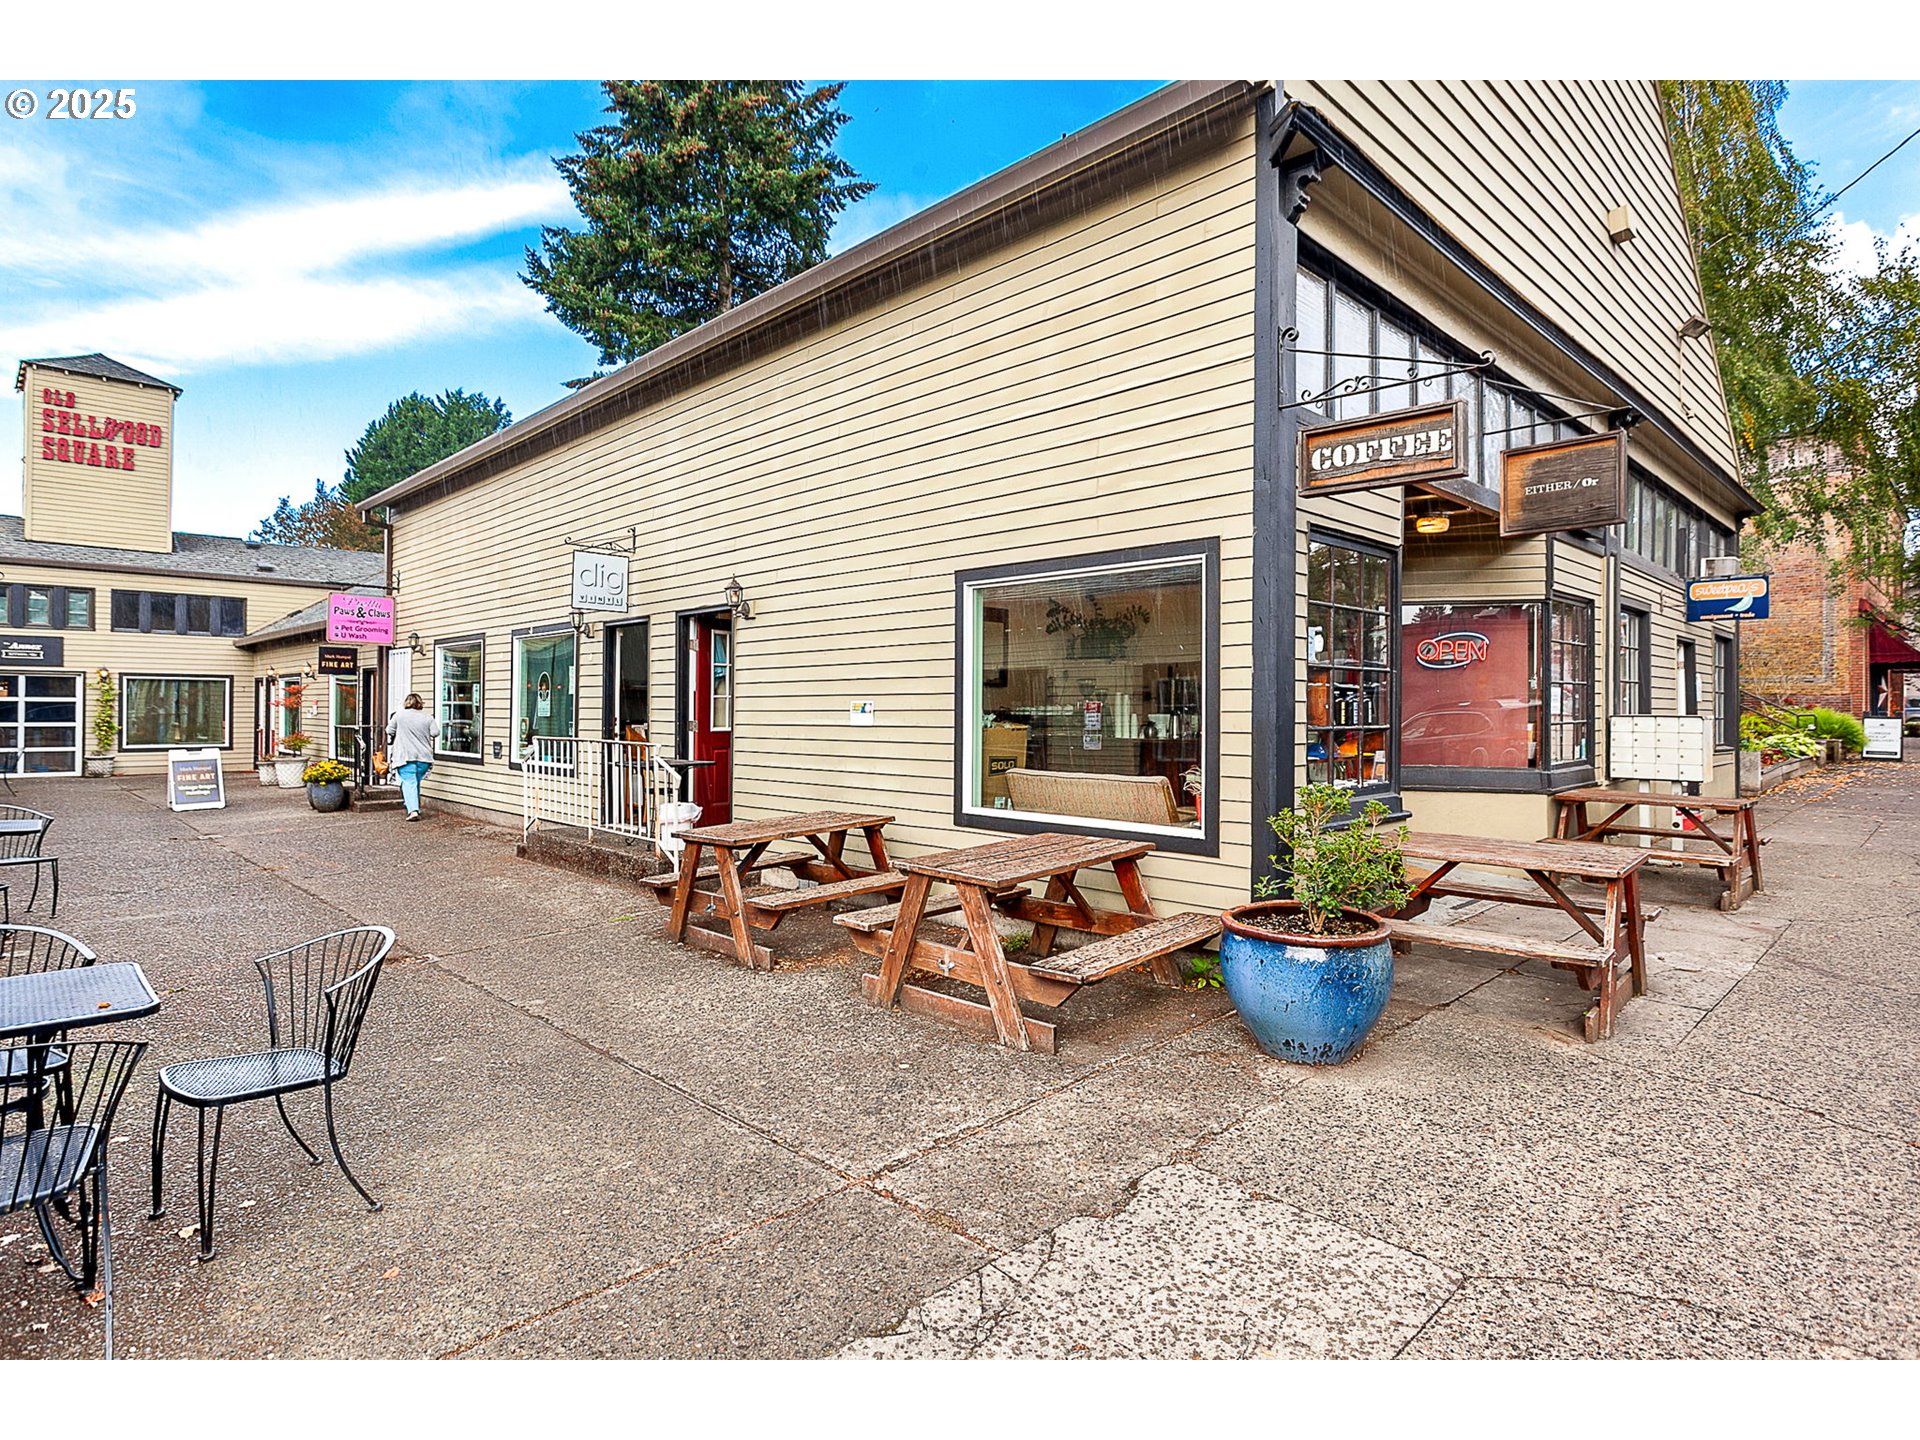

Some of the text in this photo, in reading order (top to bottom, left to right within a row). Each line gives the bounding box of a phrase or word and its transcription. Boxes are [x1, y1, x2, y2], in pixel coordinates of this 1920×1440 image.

[43, 388, 76, 408] OLD
[42, 408, 162, 448] SELLWOOD
[42, 436, 135, 471] SQUARE
[1311, 427, 1453, 472] COFFEE
[1525, 477, 1600, 496] EITHER/Or
[580, 563, 624, 596] dig
[1695, 582, 1760, 598] sweetpea's
[579, 594, 623, 606] VINYL
[333, 606, 391, 619] Paws & Claws
[355, 626, 389, 635] Grooming
[1415, 639, 1487, 662] OPEN
[321, 661, 338, 669] FINE
[176, 772, 216, 781] FINE ART
